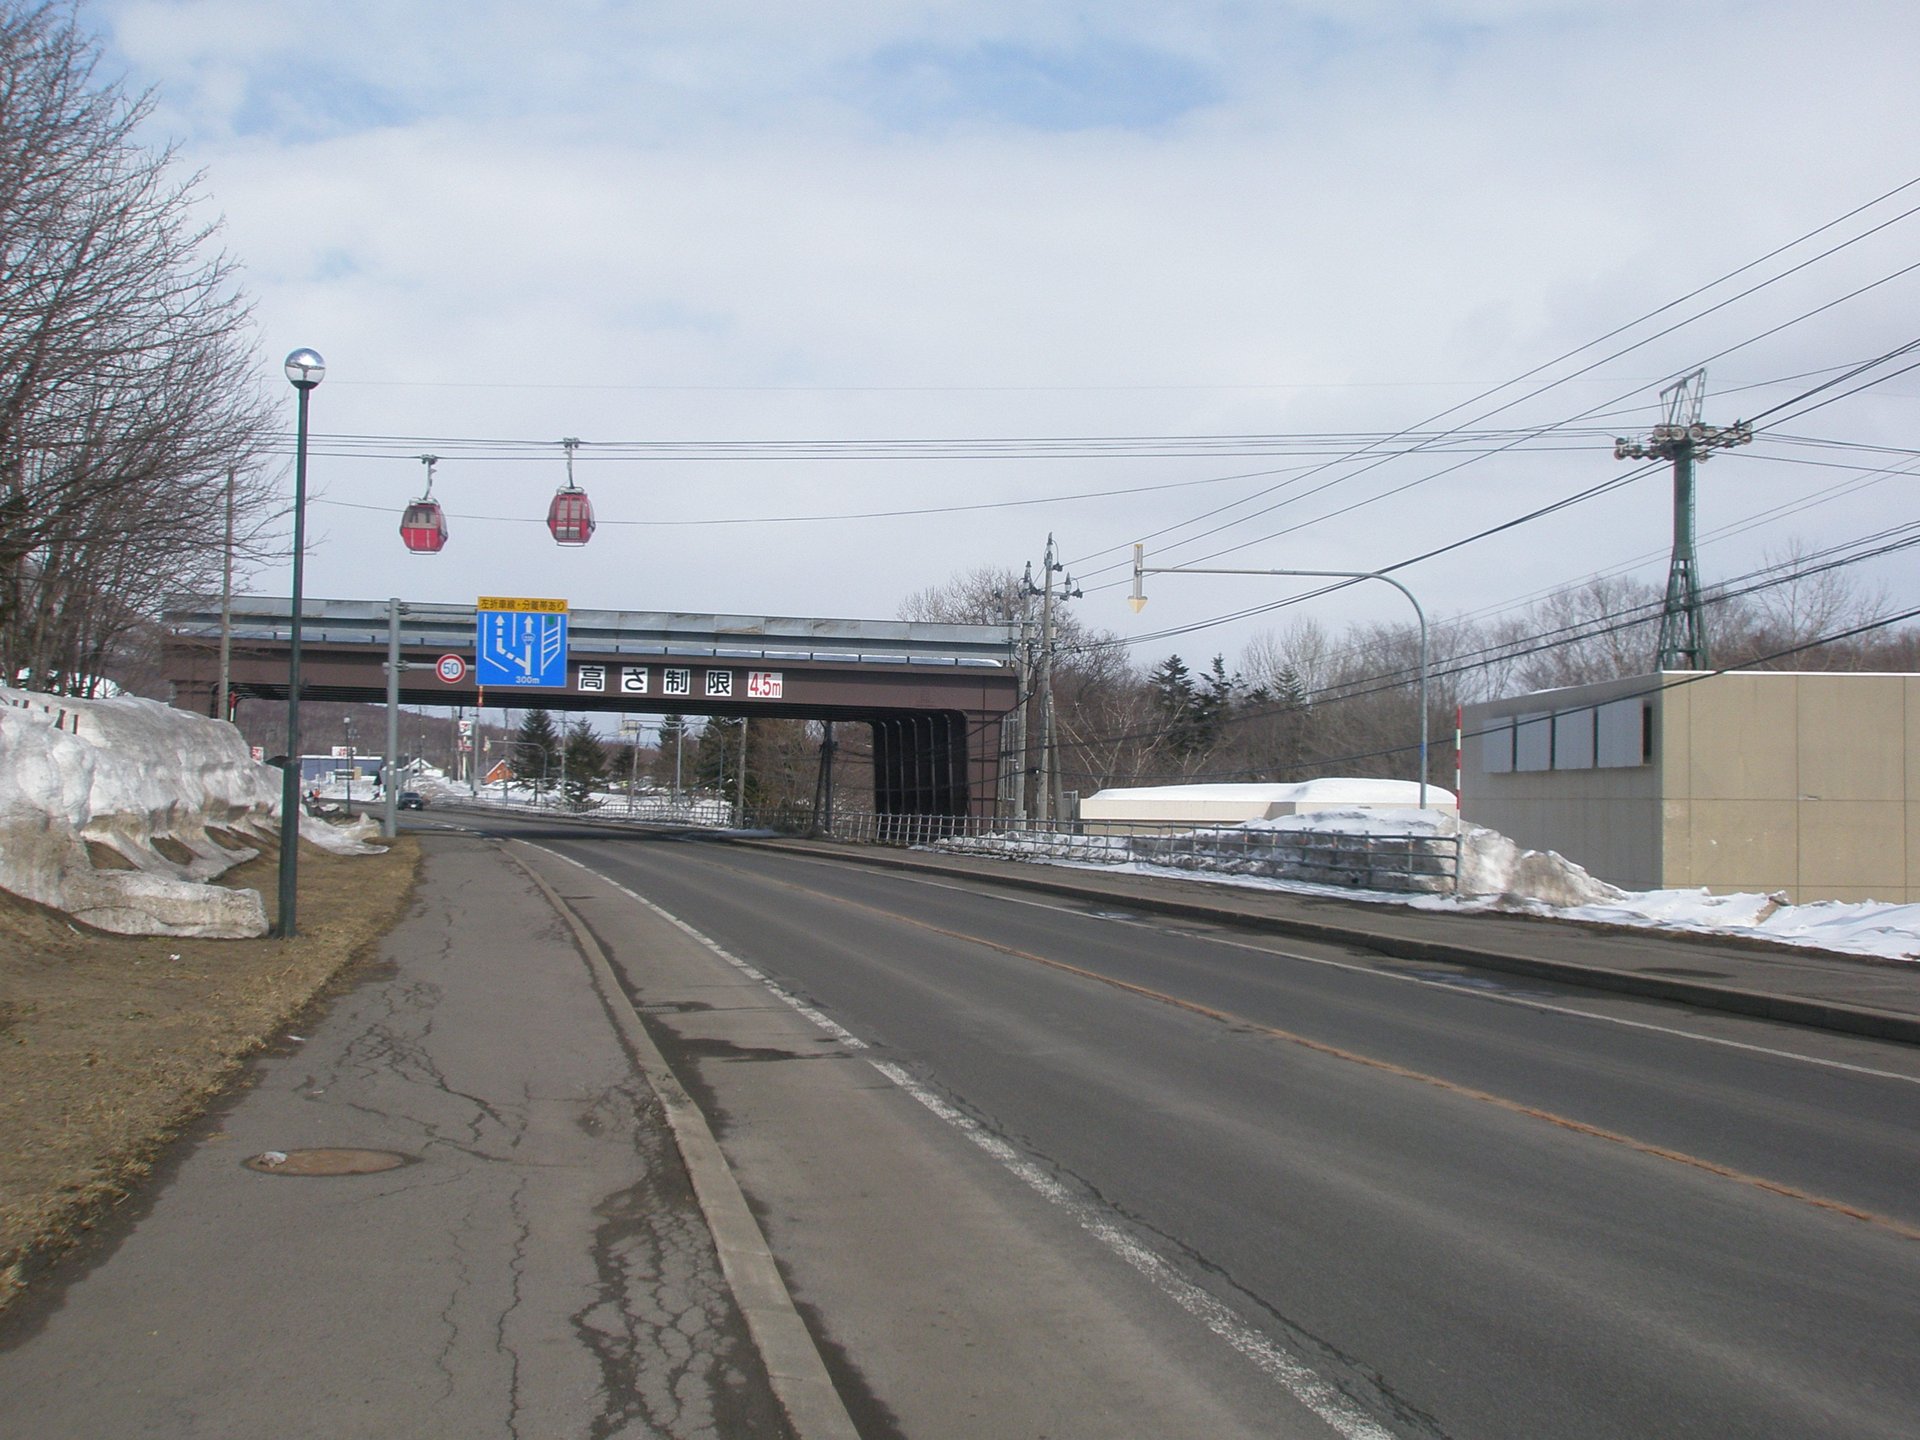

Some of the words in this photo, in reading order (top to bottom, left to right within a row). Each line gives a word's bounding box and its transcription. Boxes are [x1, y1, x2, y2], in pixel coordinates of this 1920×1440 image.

[443, 662, 459, 675] 50
[515, 676, 540, 684] 300m
[580, 666, 730, 694] 高さ制限
[749, 673, 781, 696] 4.5m
